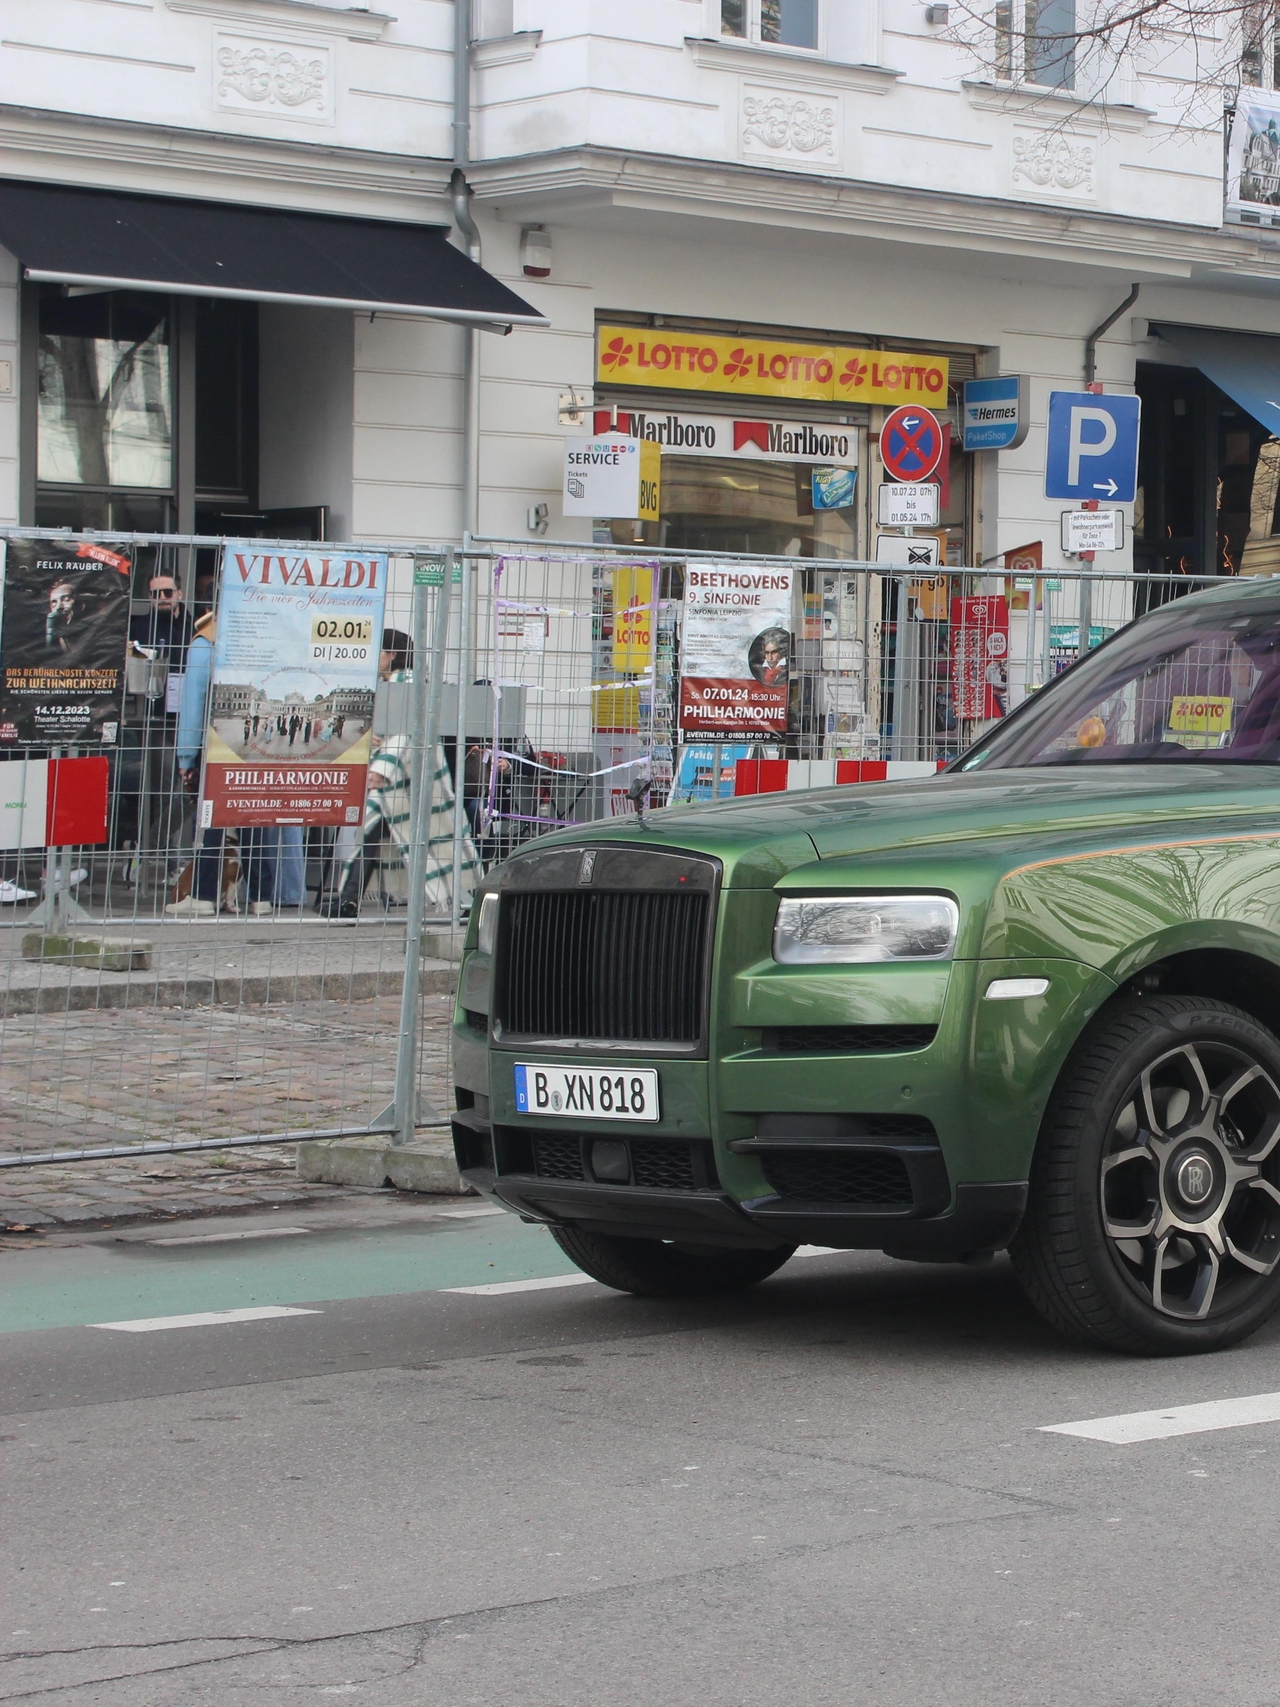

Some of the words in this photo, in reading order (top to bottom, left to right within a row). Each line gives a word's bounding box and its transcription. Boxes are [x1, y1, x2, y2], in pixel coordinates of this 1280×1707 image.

[637, 342, 719, 374] LOTTO
[757, 352, 834, 384] LOTTO
[871, 363, 944, 393] LOTTO
[979, 407, 1016, 421] Hermes
[629, 414, 716, 449] Marlboro
[967, 430, 1007, 442] PaketShop
[768, 423, 848, 459] Marlboro
[1067, 406, 1118, 487] P
[568, 452, 620, 466] SERVICE
[640, 479, 657, 512] BVG
[891, 486, 917, 497] 10.07.23
[919, 486, 933, 497] 07h
[906, 500, 917, 510] bis
[891, 512, 918, 522] 01.05.24
[920, 512, 932, 522] 17h
[36, 560, 64, 570] FELIX
[65, 561, 104, 571] RÄUBER
[233, 552, 381, 590] VIVALDI
[689, 571, 790, 590] BEETHOVENS
[927, 577, 946, 592] go
[243, 585, 268, 603] Die
[271, 590, 294, 605] vier
[296, 589, 373, 612] Jahreszeiten
[689, 591, 700, 604] 9.
[703, 592, 762, 606] SINFONIE
[688, 608, 719, 616] SINFONIA
[719, 608, 742, 617] LEIPZIG
[316, 620, 367, 639] 02.01.
[616, 629, 651, 646] LOTTO
[313, 646, 326, 659] DI
[334, 647, 367, 660] 20.00
[6, 668, 22, 677] DAS
[84, 669, 119, 678] KONZERT
[5, 677, 27, 689] ZUR
[29, 678, 118, 689] WEIHNACHTSZEIT
[690, 691, 701, 700] So.
[703, 687, 749, 700] 07.01.24
[750, 693, 769, 701] 15:30
[769, 693, 781, 702] Uhr
[34, 705, 91, 715] 14.12.2023
[683, 704, 786, 720] PHILHARMONIE
[1189, 703, 1225, 718] LOTTO
[34, 715, 60, 723] Theater
[59, 715, 91, 723] Schalotte
[686, 731, 725, 739] EVENTIM.DE
[224, 770, 349, 786] PHILHARMONIE
[226, 799, 282, 808] EVENTIM.DE
[289, 799, 312, 808] 01806
[312, 799, 322, 808] 57
[322, 799, 333, 808] 00
[333, 799, 343, 808] 70
[519, 1093, 525, 1104] D
[535, 1072, 549, 1108] B
[564, 1073, 595, 1111] XN
[600, 1075, 645, 1113] 818
